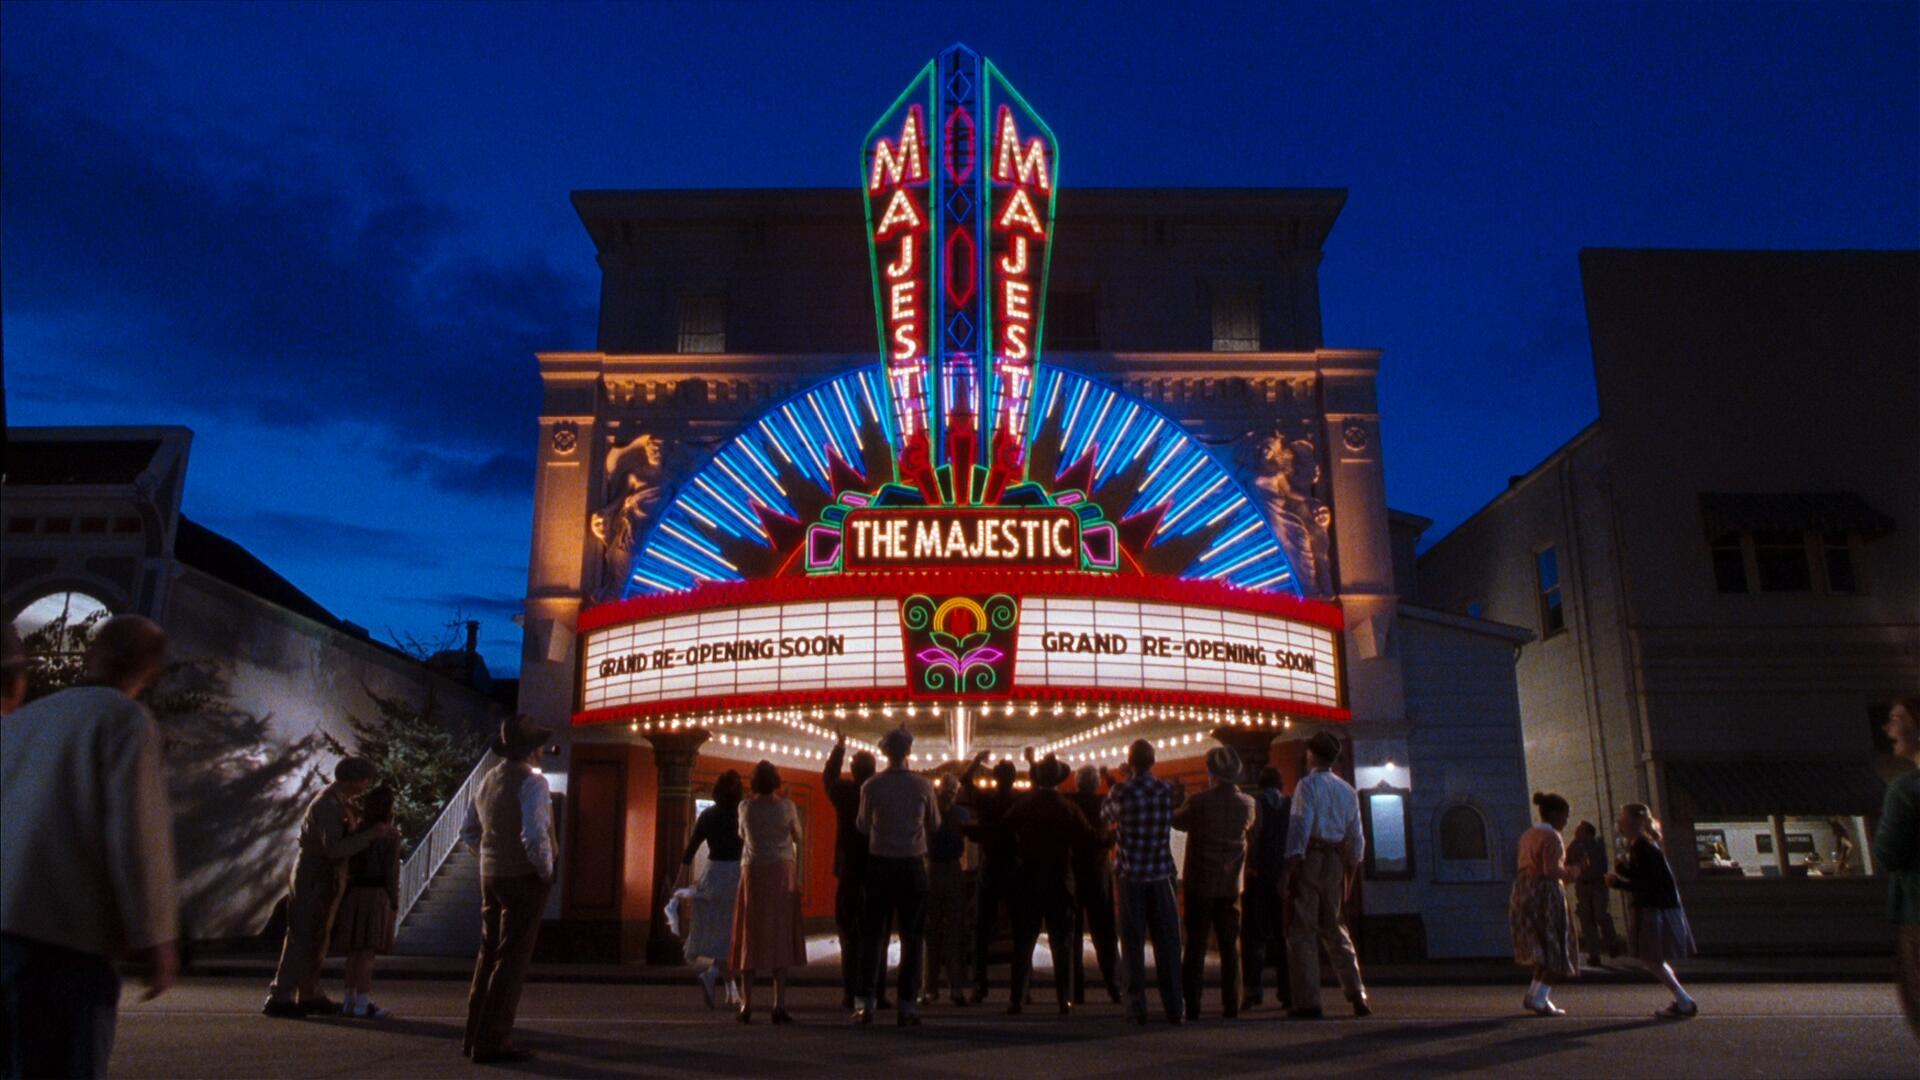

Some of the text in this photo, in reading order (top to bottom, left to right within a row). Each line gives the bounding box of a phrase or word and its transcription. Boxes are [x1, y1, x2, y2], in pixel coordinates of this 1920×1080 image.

[852, 518, 1072, 559] THE MAJESTIC
[599, 635, 845, 679] GRAND RE-OPENING SOON
[1041, 631, 1316, 674] GRAND RE-OPENING SOON
